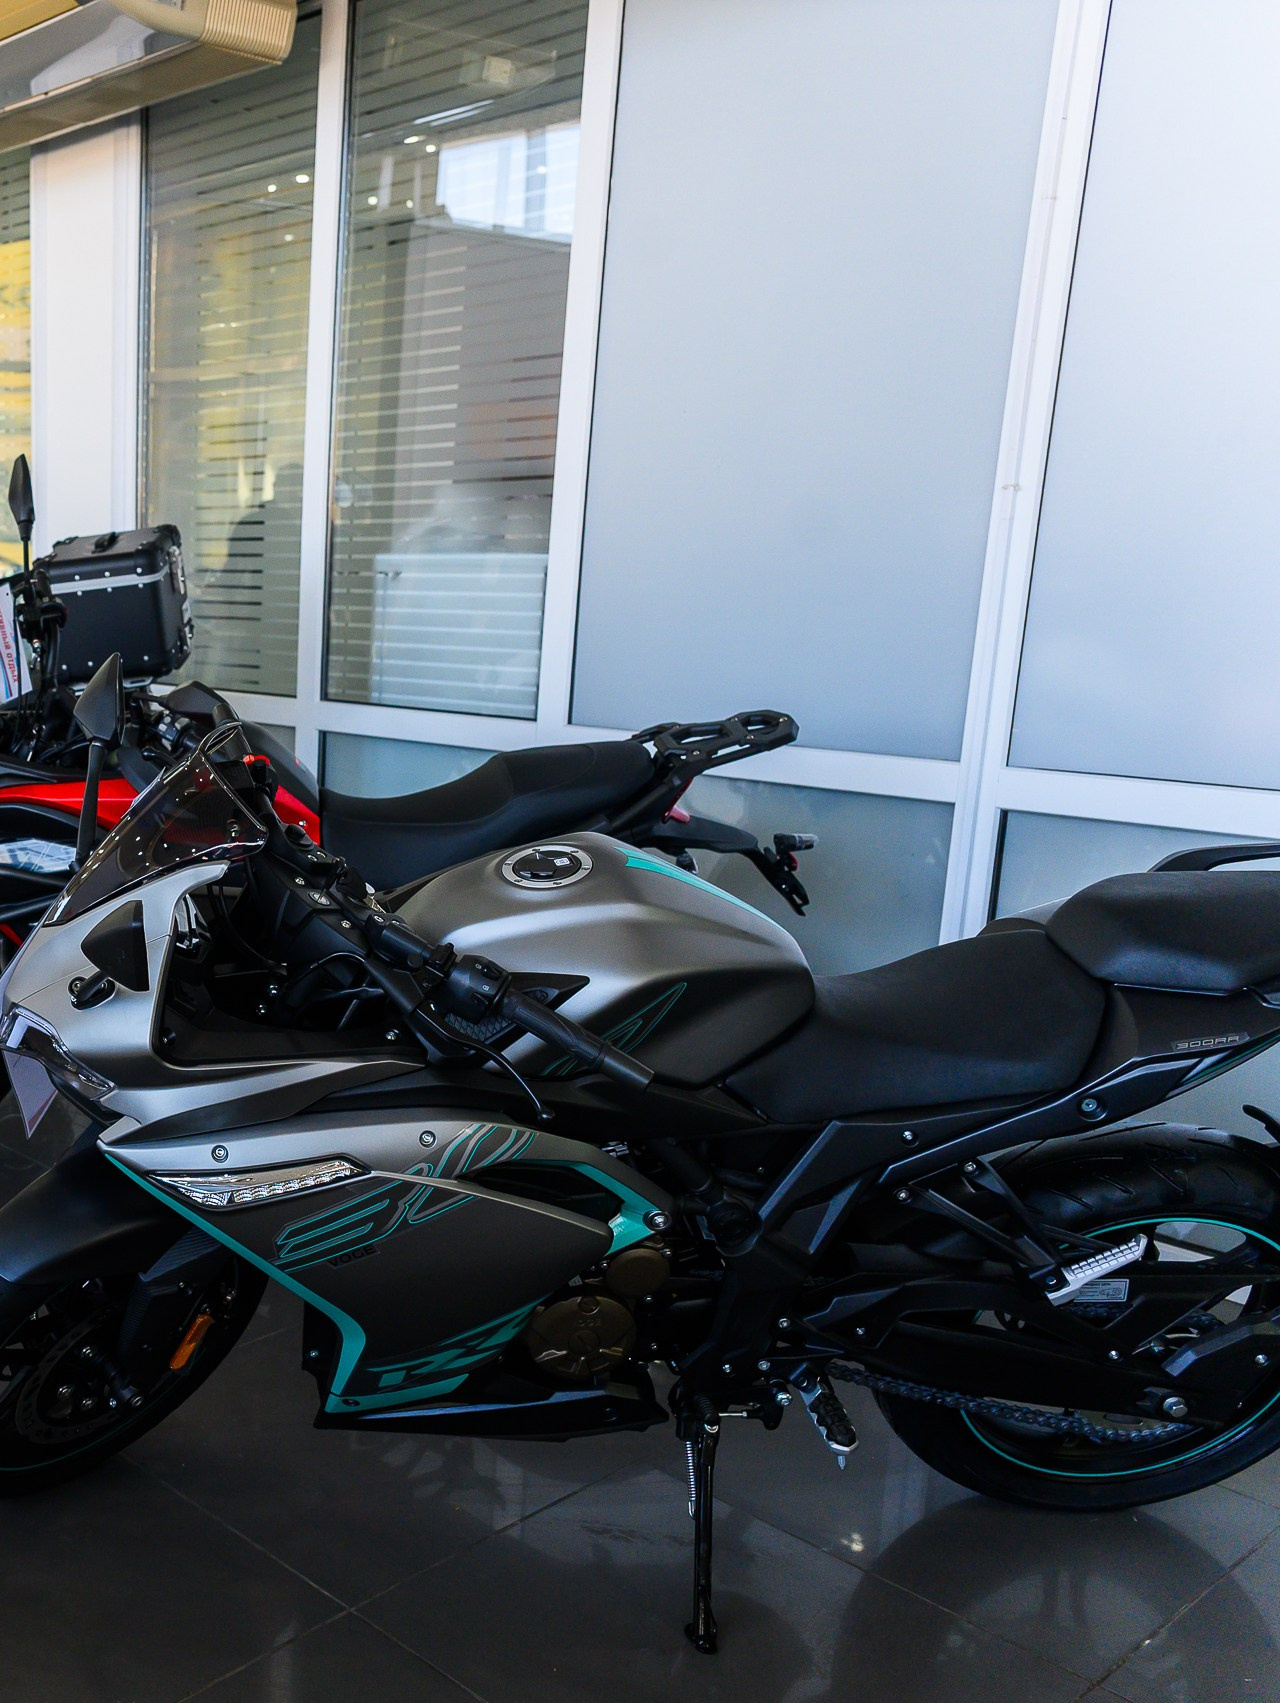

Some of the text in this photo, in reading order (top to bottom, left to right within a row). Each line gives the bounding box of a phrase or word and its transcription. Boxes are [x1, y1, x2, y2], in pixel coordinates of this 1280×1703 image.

[6, 652, 19, 683] ОТДЫХ
[1176, 1035, 1240, 1050] 300RR
[326, 1243, 377, 1267] VOGE
